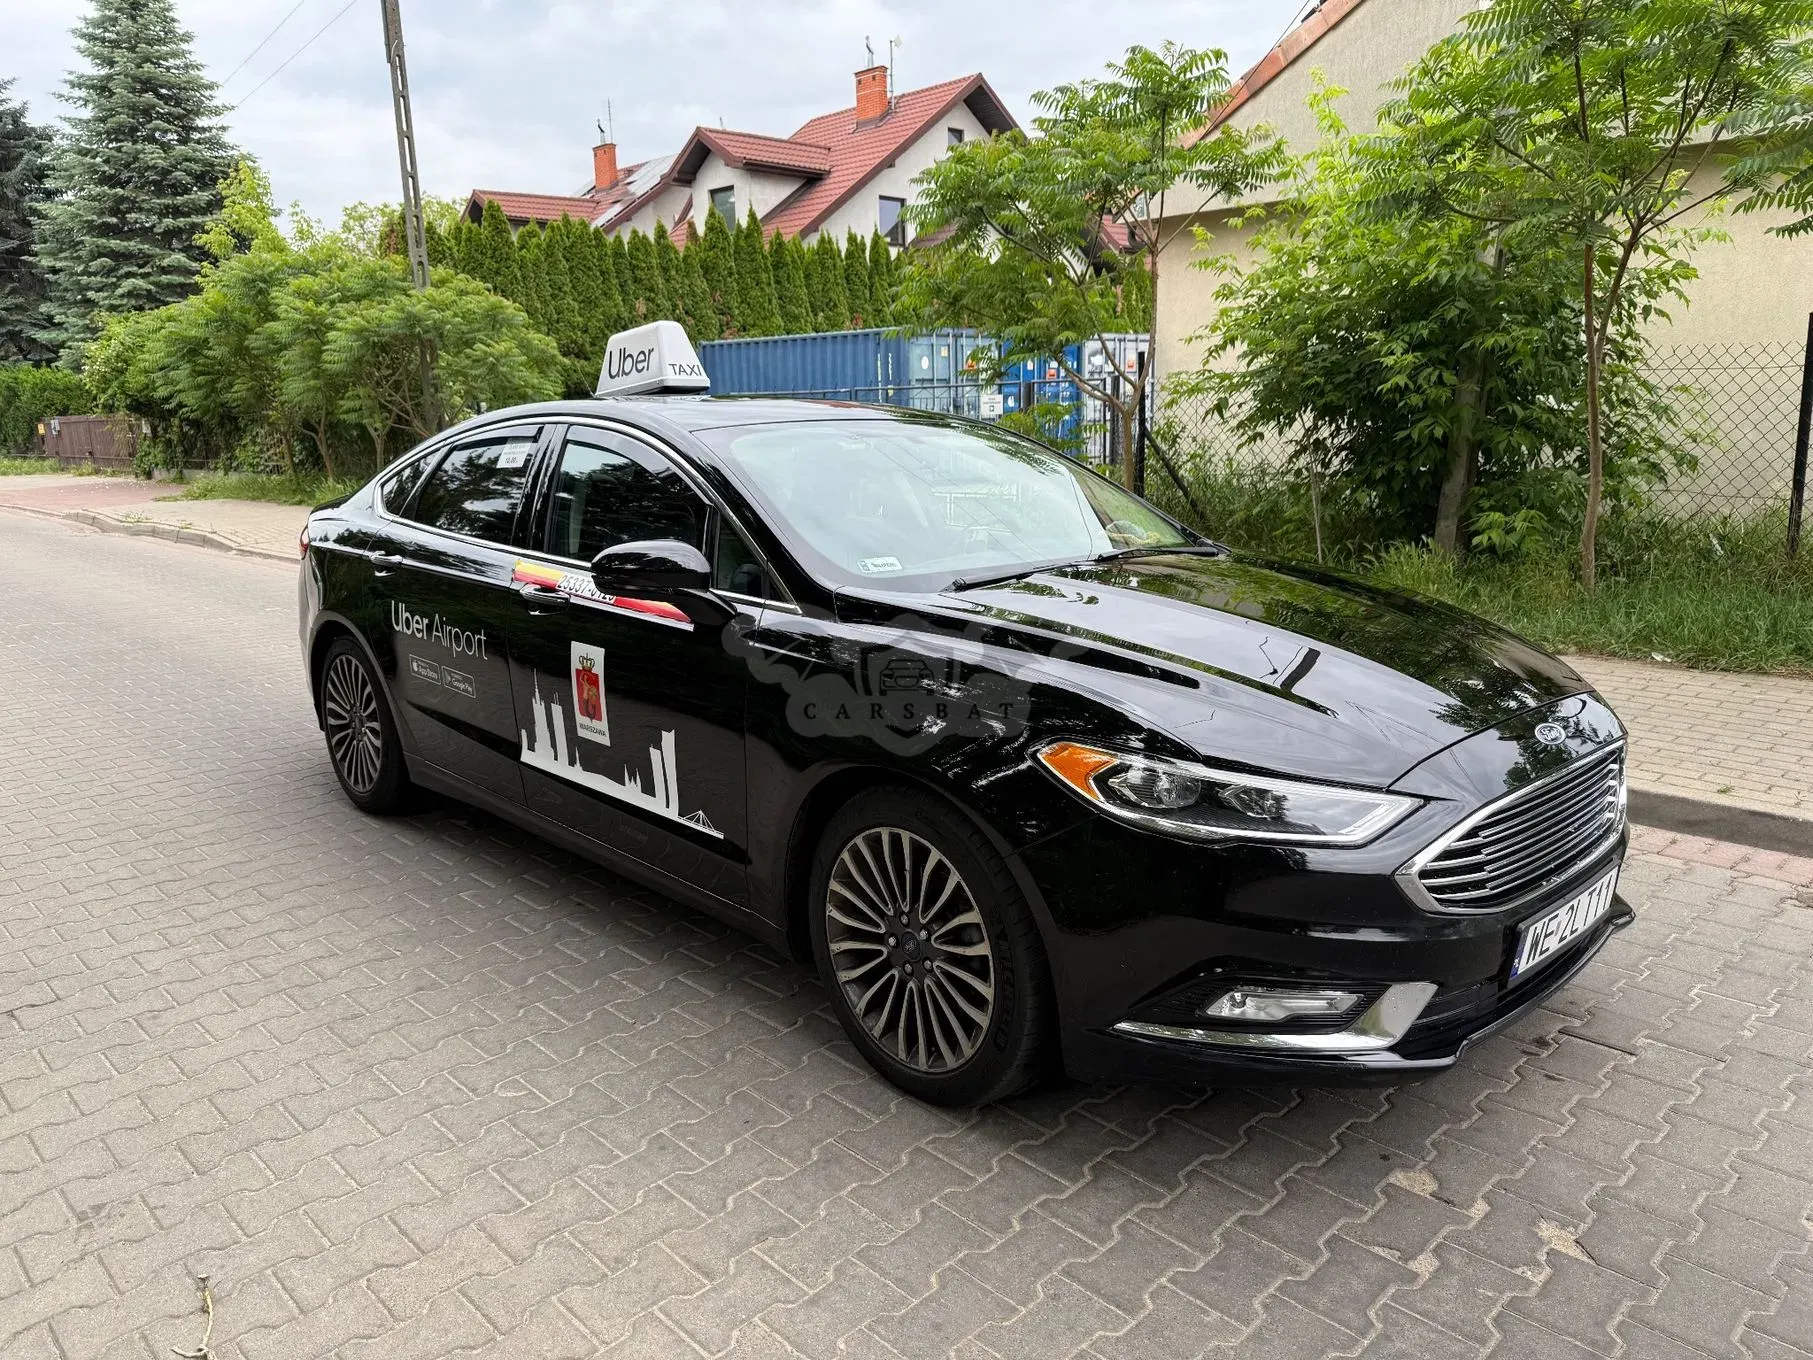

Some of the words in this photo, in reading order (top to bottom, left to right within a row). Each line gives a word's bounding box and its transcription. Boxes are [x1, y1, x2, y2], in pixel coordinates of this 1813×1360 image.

[608, 347, 654, 379] Uber
[668, 363, 702, 377] TAXI
[391, 600, 428, 640] Uber
[432, 613, 488, 660] Airport
[579, 722, 607, 737] WARSZAWA
[1526, 913, 1560, 965] WE
